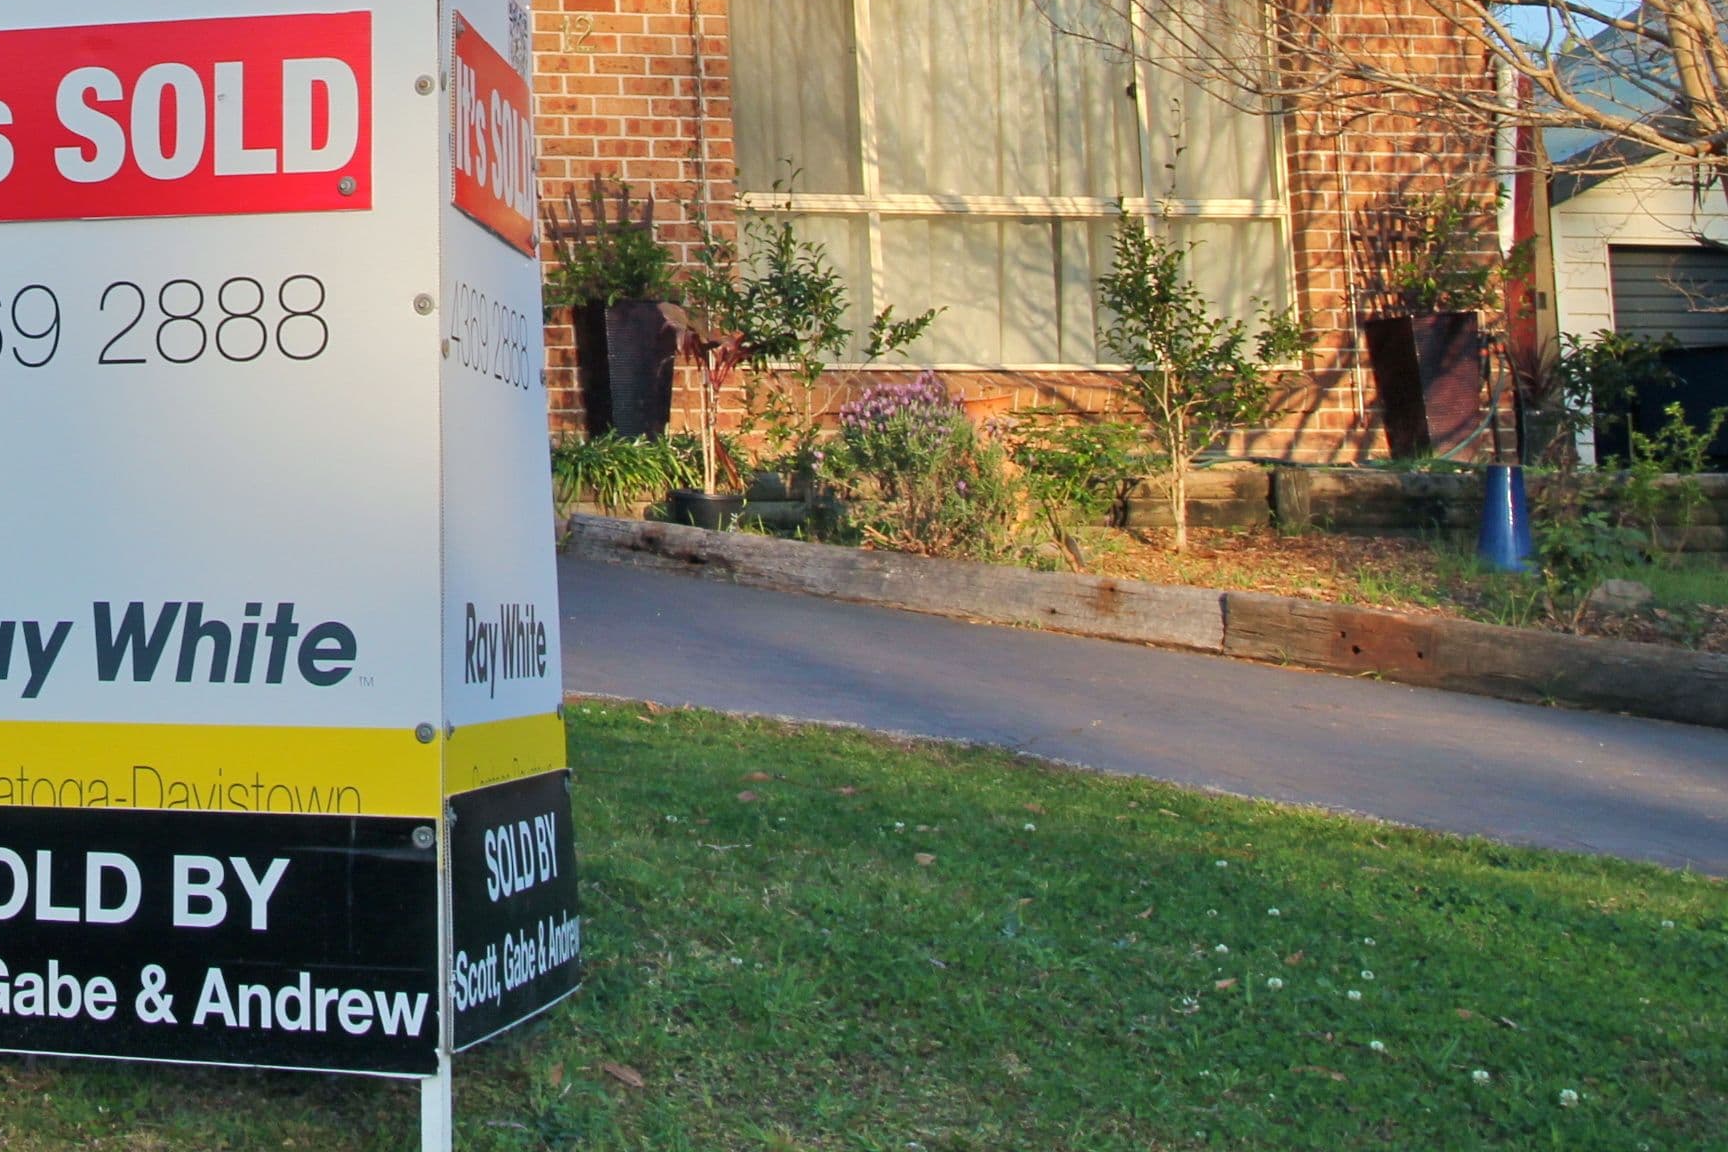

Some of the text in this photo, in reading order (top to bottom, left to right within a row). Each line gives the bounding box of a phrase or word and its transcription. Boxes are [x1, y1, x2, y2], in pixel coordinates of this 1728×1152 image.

[562, 15, 596, 53] 12
[55, 58, 360, 183] SOLD
[456, 55, 534, 221] It's SOLD
[98, 275, 329, 365] 2888
[451, 281, 529, 390] 4369 2888
[92, 602, 358, 687] White
[466, 602, 546, 699] Ray White
[173, 855, 291, 931] BY
[485, 812, 558, 902] SOLD BY
[136, 964, 178, 1024] &
[193, 967, 429, 1037] Andrew
[456, 950, 501, 1007] Scott,
[504, 928, 536, 991] Gabe
[538, 920, 547, 975] &
